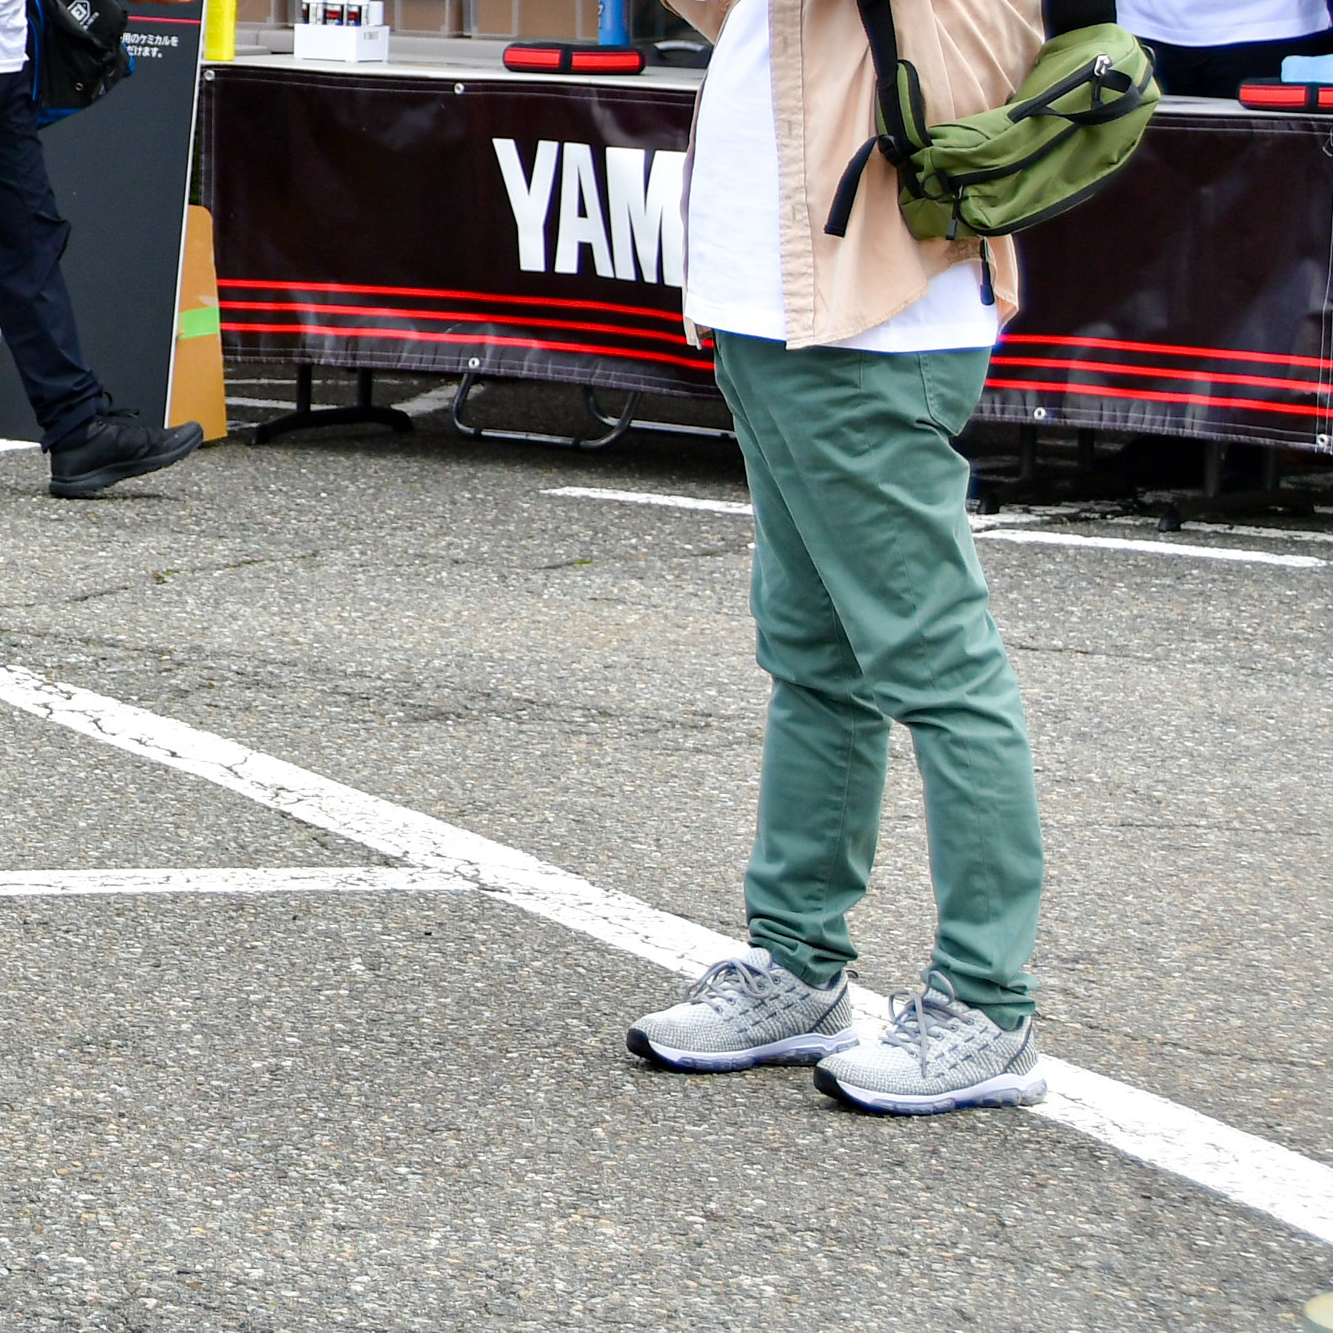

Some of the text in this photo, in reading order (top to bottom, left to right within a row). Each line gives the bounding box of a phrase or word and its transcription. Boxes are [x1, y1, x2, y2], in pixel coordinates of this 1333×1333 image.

[121, 32, 179, 48] 用のケミカルを
